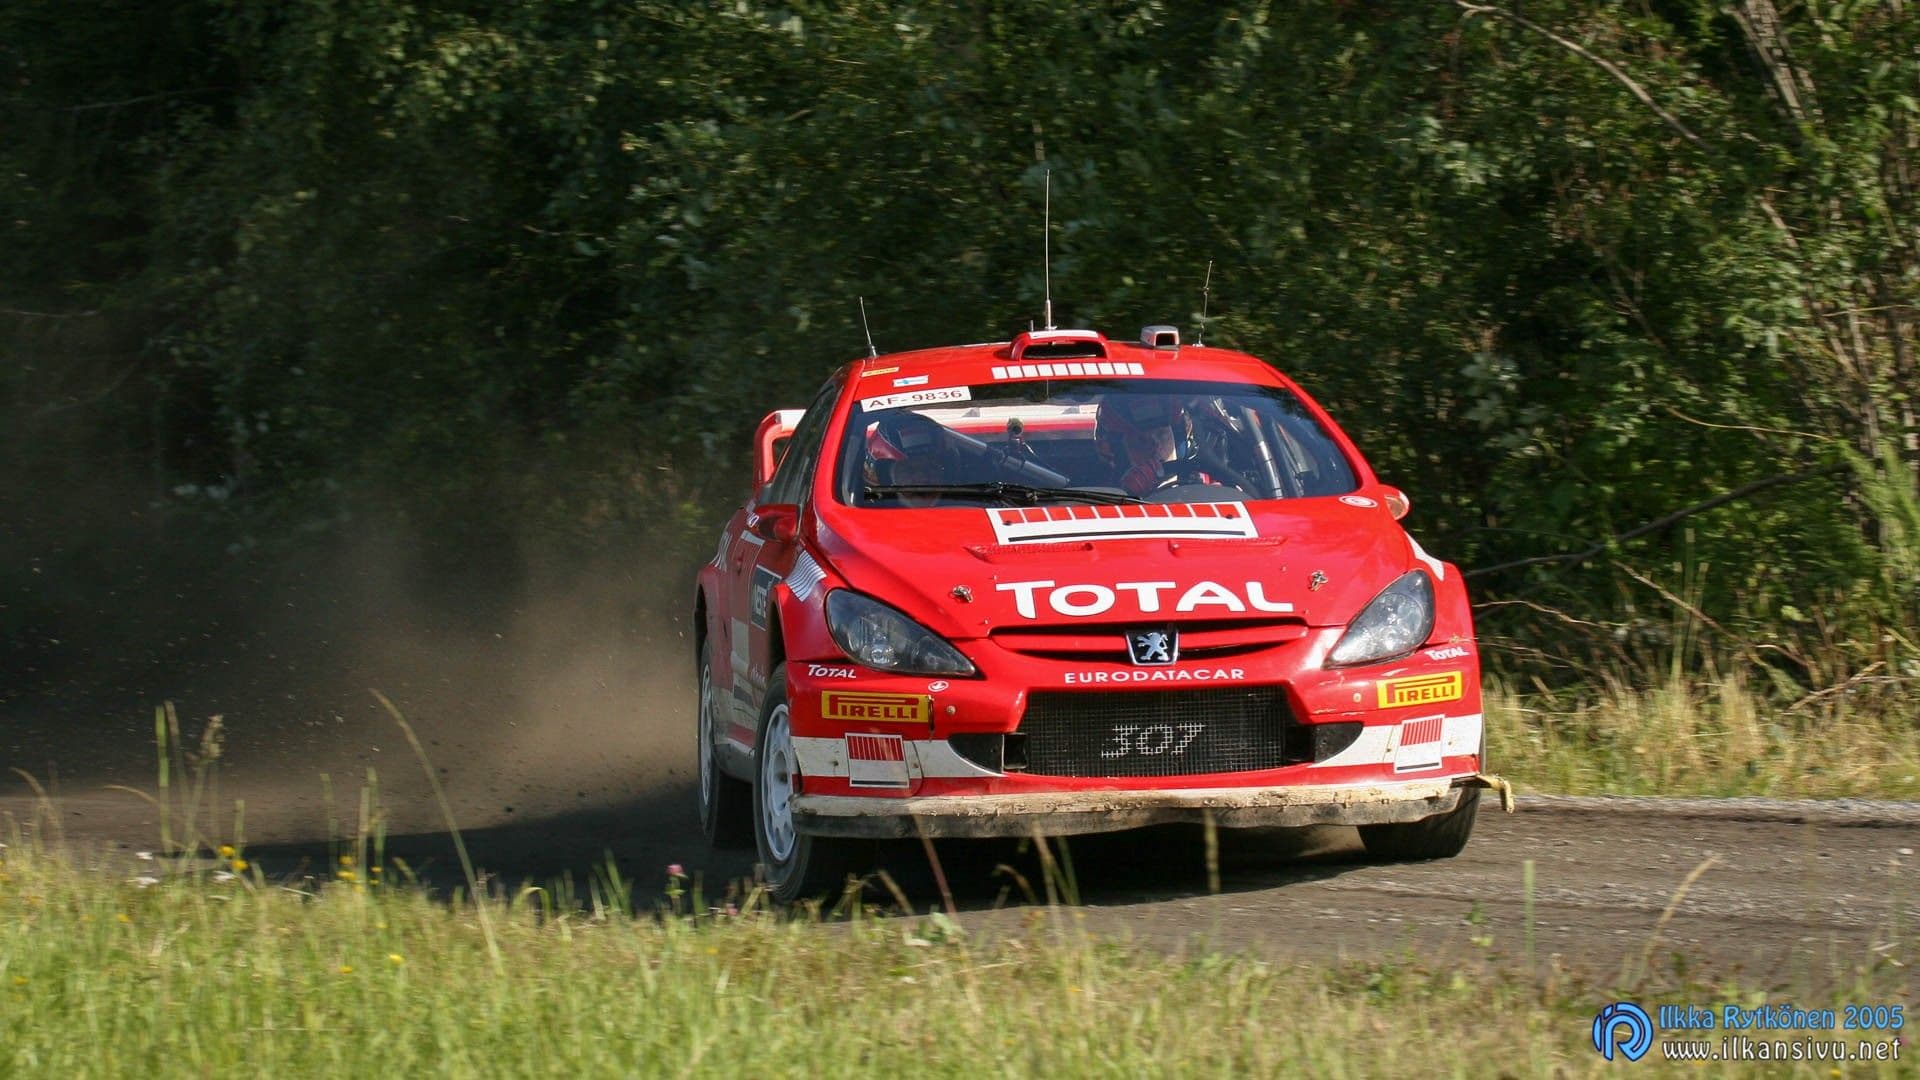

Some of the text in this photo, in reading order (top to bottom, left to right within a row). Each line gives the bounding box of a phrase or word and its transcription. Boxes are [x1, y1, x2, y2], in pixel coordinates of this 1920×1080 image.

[869, 390, 962, 408] AF-9836
[995, 580, 1294, 620] TOTAL
[1424, 646, 1470, 661] TOTAL
[808, 664, 857, 678] TOTAL
[1065, 668, 1245, 684] EURODATACAR
[1386, 675, 1456, 704] PIRELLI
[829, 694, 919, 719] PIRELLI
[1101, 723, 1207, 759] 307
